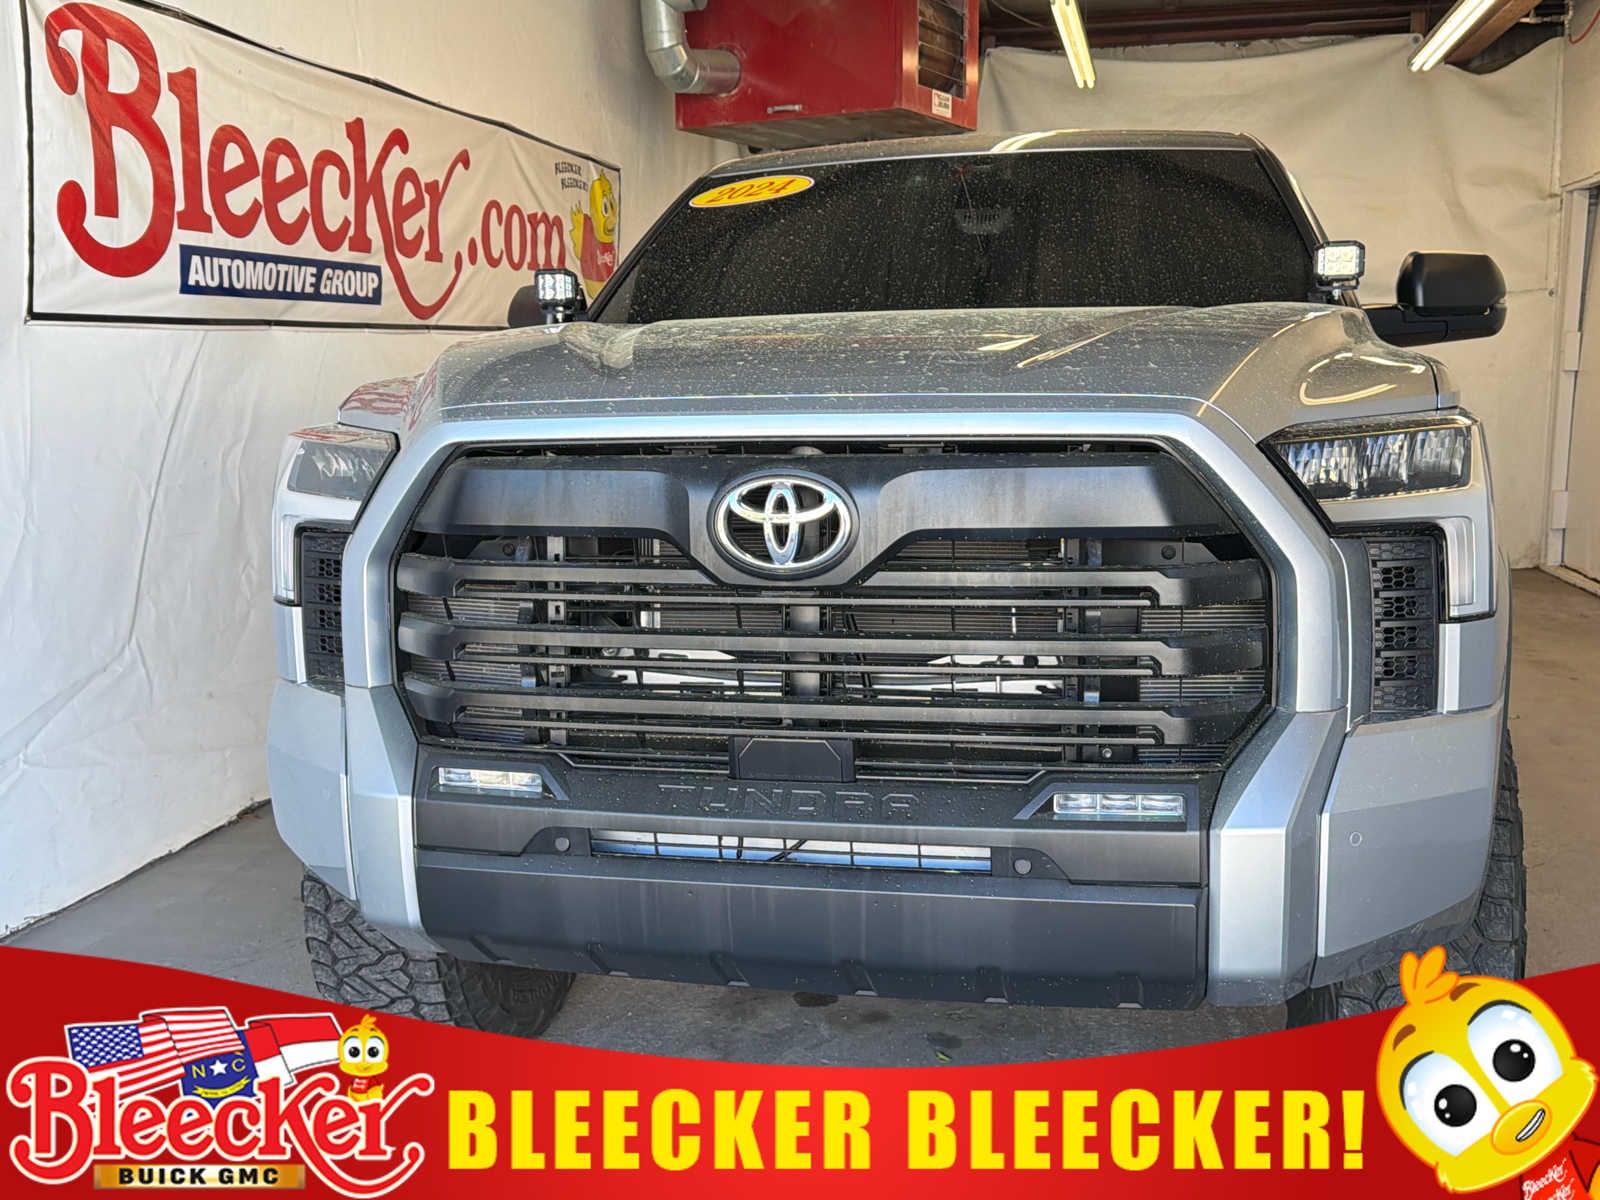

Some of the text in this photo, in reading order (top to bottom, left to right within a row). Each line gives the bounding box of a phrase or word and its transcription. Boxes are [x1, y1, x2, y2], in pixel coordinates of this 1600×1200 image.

[705, 178, 797, 204] 2024
[187, 254, 379, 298] AUTOMOTIVE GROUP
[657, 783, 922, 821] TUNDRA
